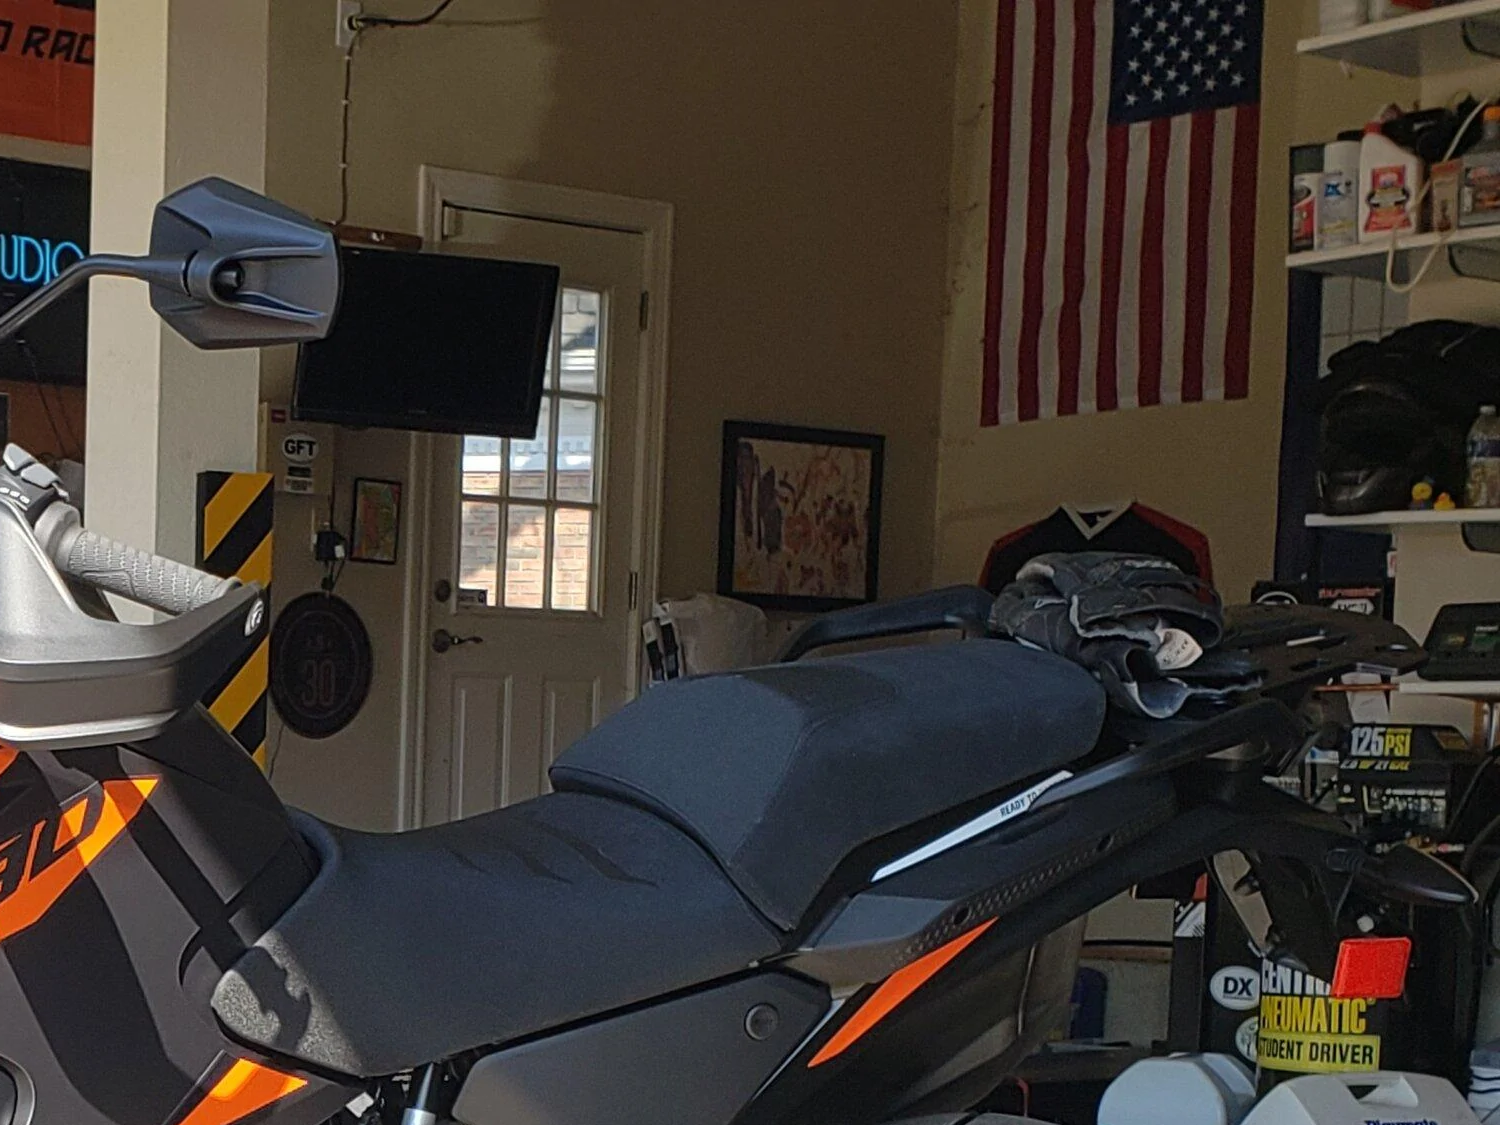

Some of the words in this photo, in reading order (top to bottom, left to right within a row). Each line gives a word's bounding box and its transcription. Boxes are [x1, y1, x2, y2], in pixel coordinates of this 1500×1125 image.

[284, 438, 317, 455] GFT
[1350, 726, 1386, 757] 125
[1384, 734, 1412, 757] PSI
[1222, 976, 1254, 996] DX
[1260, 994, 1367, 1034] PNEUMATIC
[1308, 1041, 1374, 1065] DRIVER
